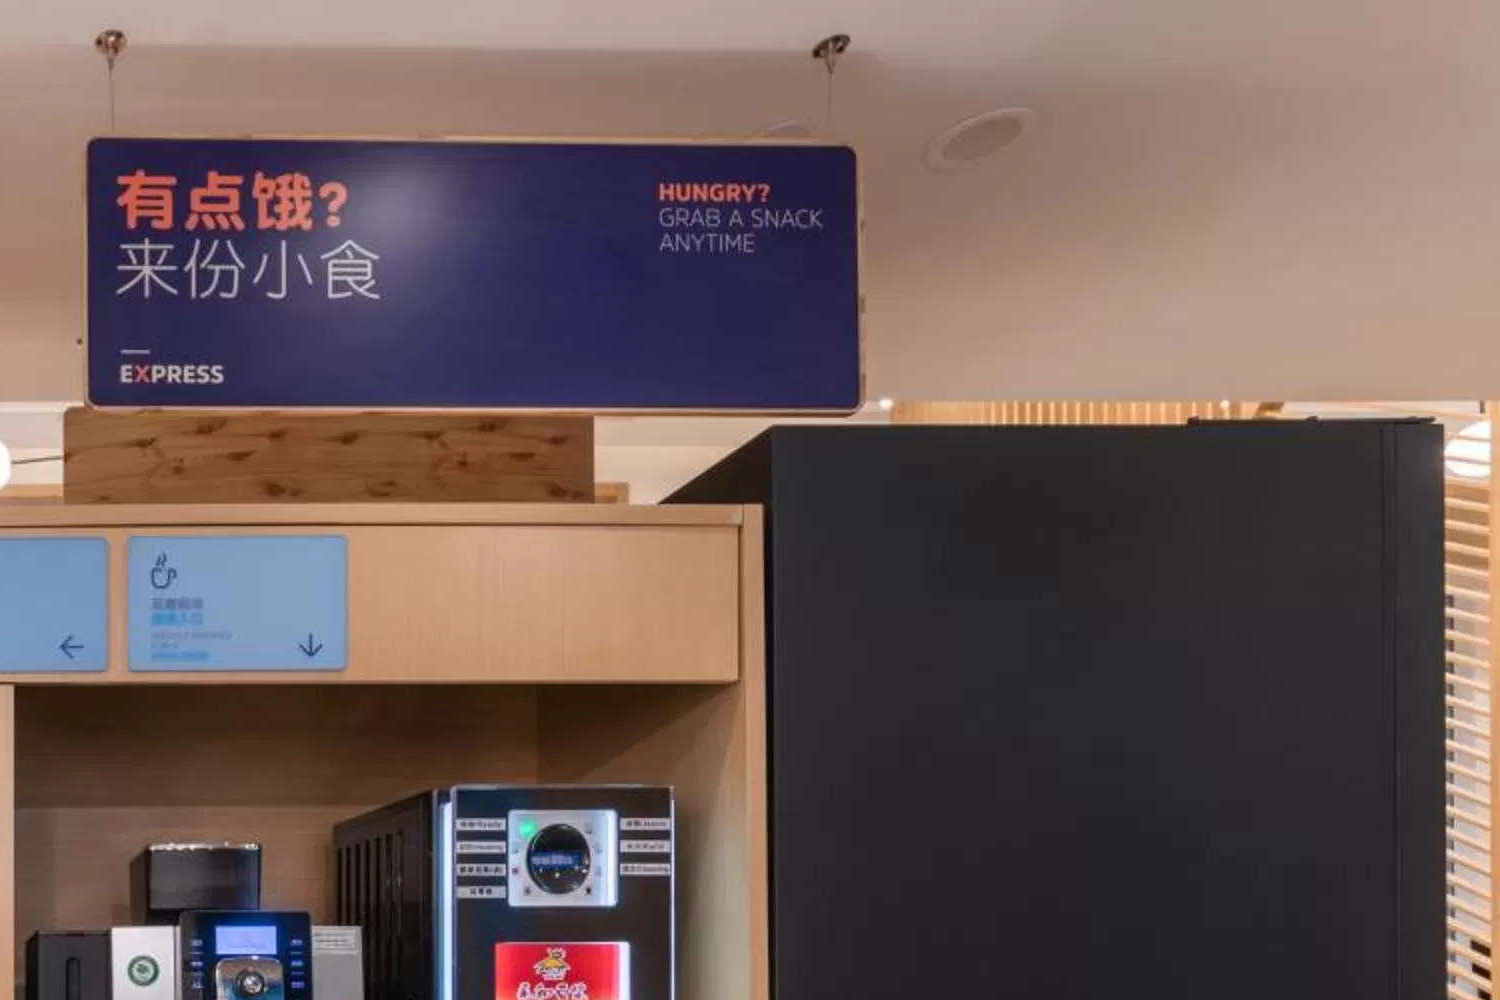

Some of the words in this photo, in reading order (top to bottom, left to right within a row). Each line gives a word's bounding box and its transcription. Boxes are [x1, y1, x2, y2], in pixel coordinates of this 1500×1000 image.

[116, 170, 348, 232] 有点饿?
[658, 182, 770, 203] HUNGRY?
[658, 207, 722, 228] GRAB
[728, 208, 745, 228] A
[750, 208, 824, 229] SNACK
[658, 231, 756, 253] ANYTIME
[116, 239, 381, 300] 来份小食
[119, 364, 225, 384] EXPRESS
